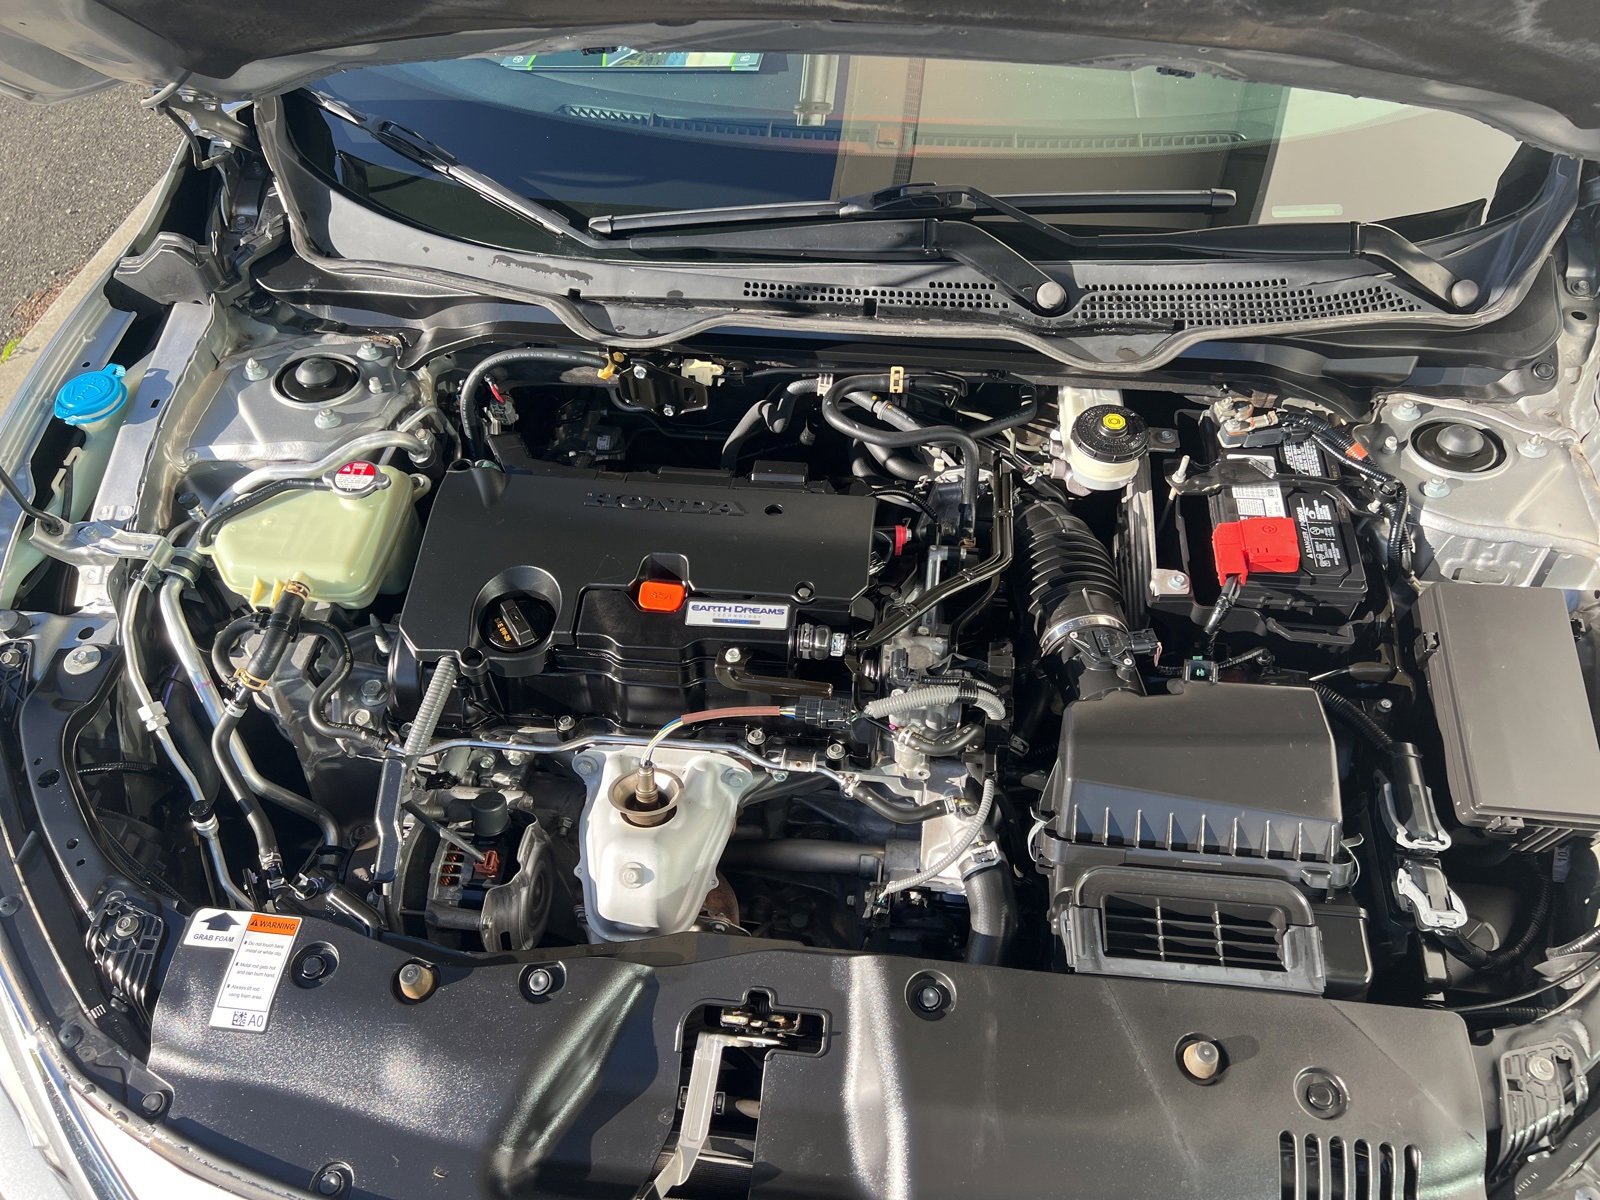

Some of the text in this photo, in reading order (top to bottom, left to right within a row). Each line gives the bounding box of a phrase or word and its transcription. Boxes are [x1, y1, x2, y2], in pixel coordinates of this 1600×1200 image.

[584, 492, 746, 516] HONDA
[691, 604, 785, 616] EARTH DREAMS
[259, 920, 296, 931] WARNING
[193, 933, 235, 943] GRAB FOAM
[247, 1014, 264, 1028] A0
